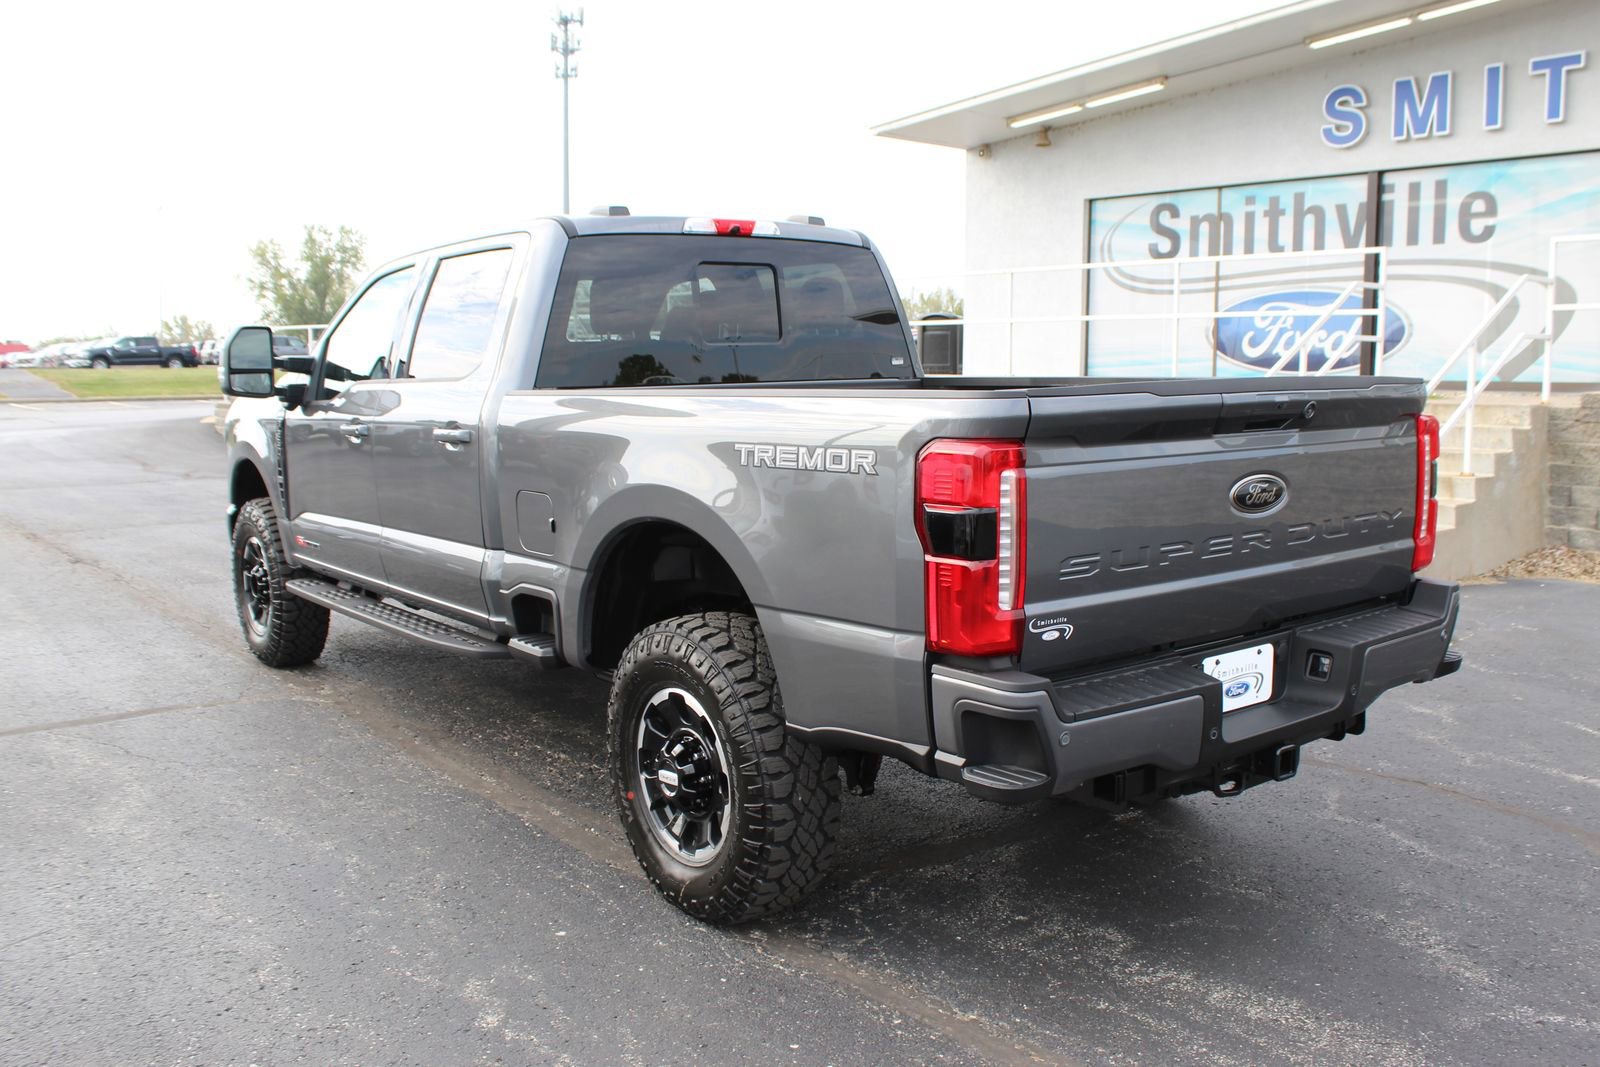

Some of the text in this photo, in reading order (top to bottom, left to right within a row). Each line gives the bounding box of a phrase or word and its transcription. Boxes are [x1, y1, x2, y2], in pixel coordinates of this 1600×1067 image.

[1320, 50, 1587, 149] SMIT
[1148, 179, 1498, 259] Smithville
[1241, 301, 1366, 360] Ford
[734, 443, 879, 476] TREMOR
[1246, 482, 1277, 505] Ford
[1059, 508, 1403, 581] SUPER DUTY
